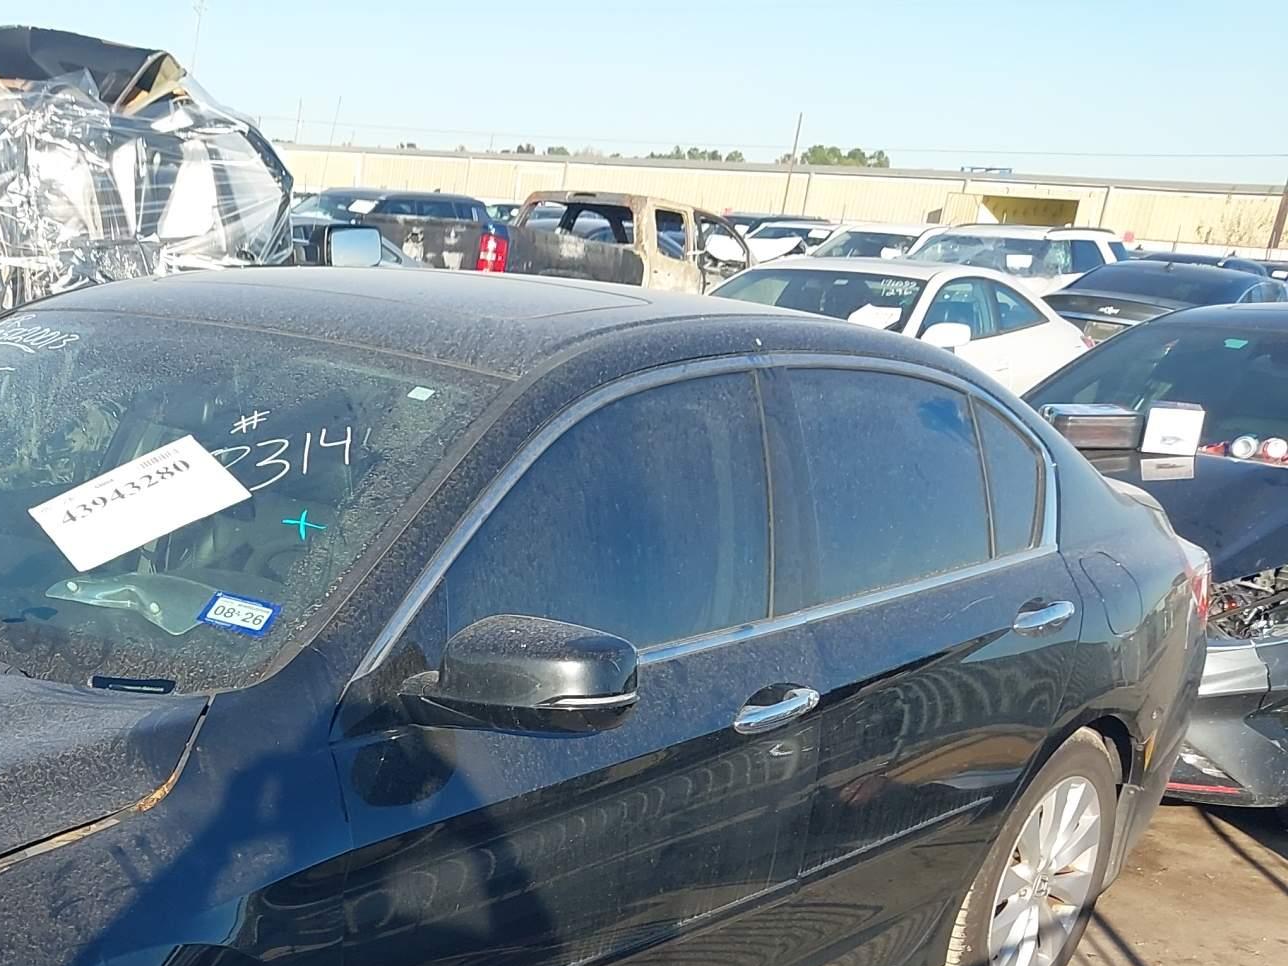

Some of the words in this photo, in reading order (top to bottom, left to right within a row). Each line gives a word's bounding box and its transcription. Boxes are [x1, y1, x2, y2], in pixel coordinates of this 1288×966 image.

[61, 459, 191, 524] 43943280
[214, 605, 236, 618] 08
[240, 611, 265, 626] 26
